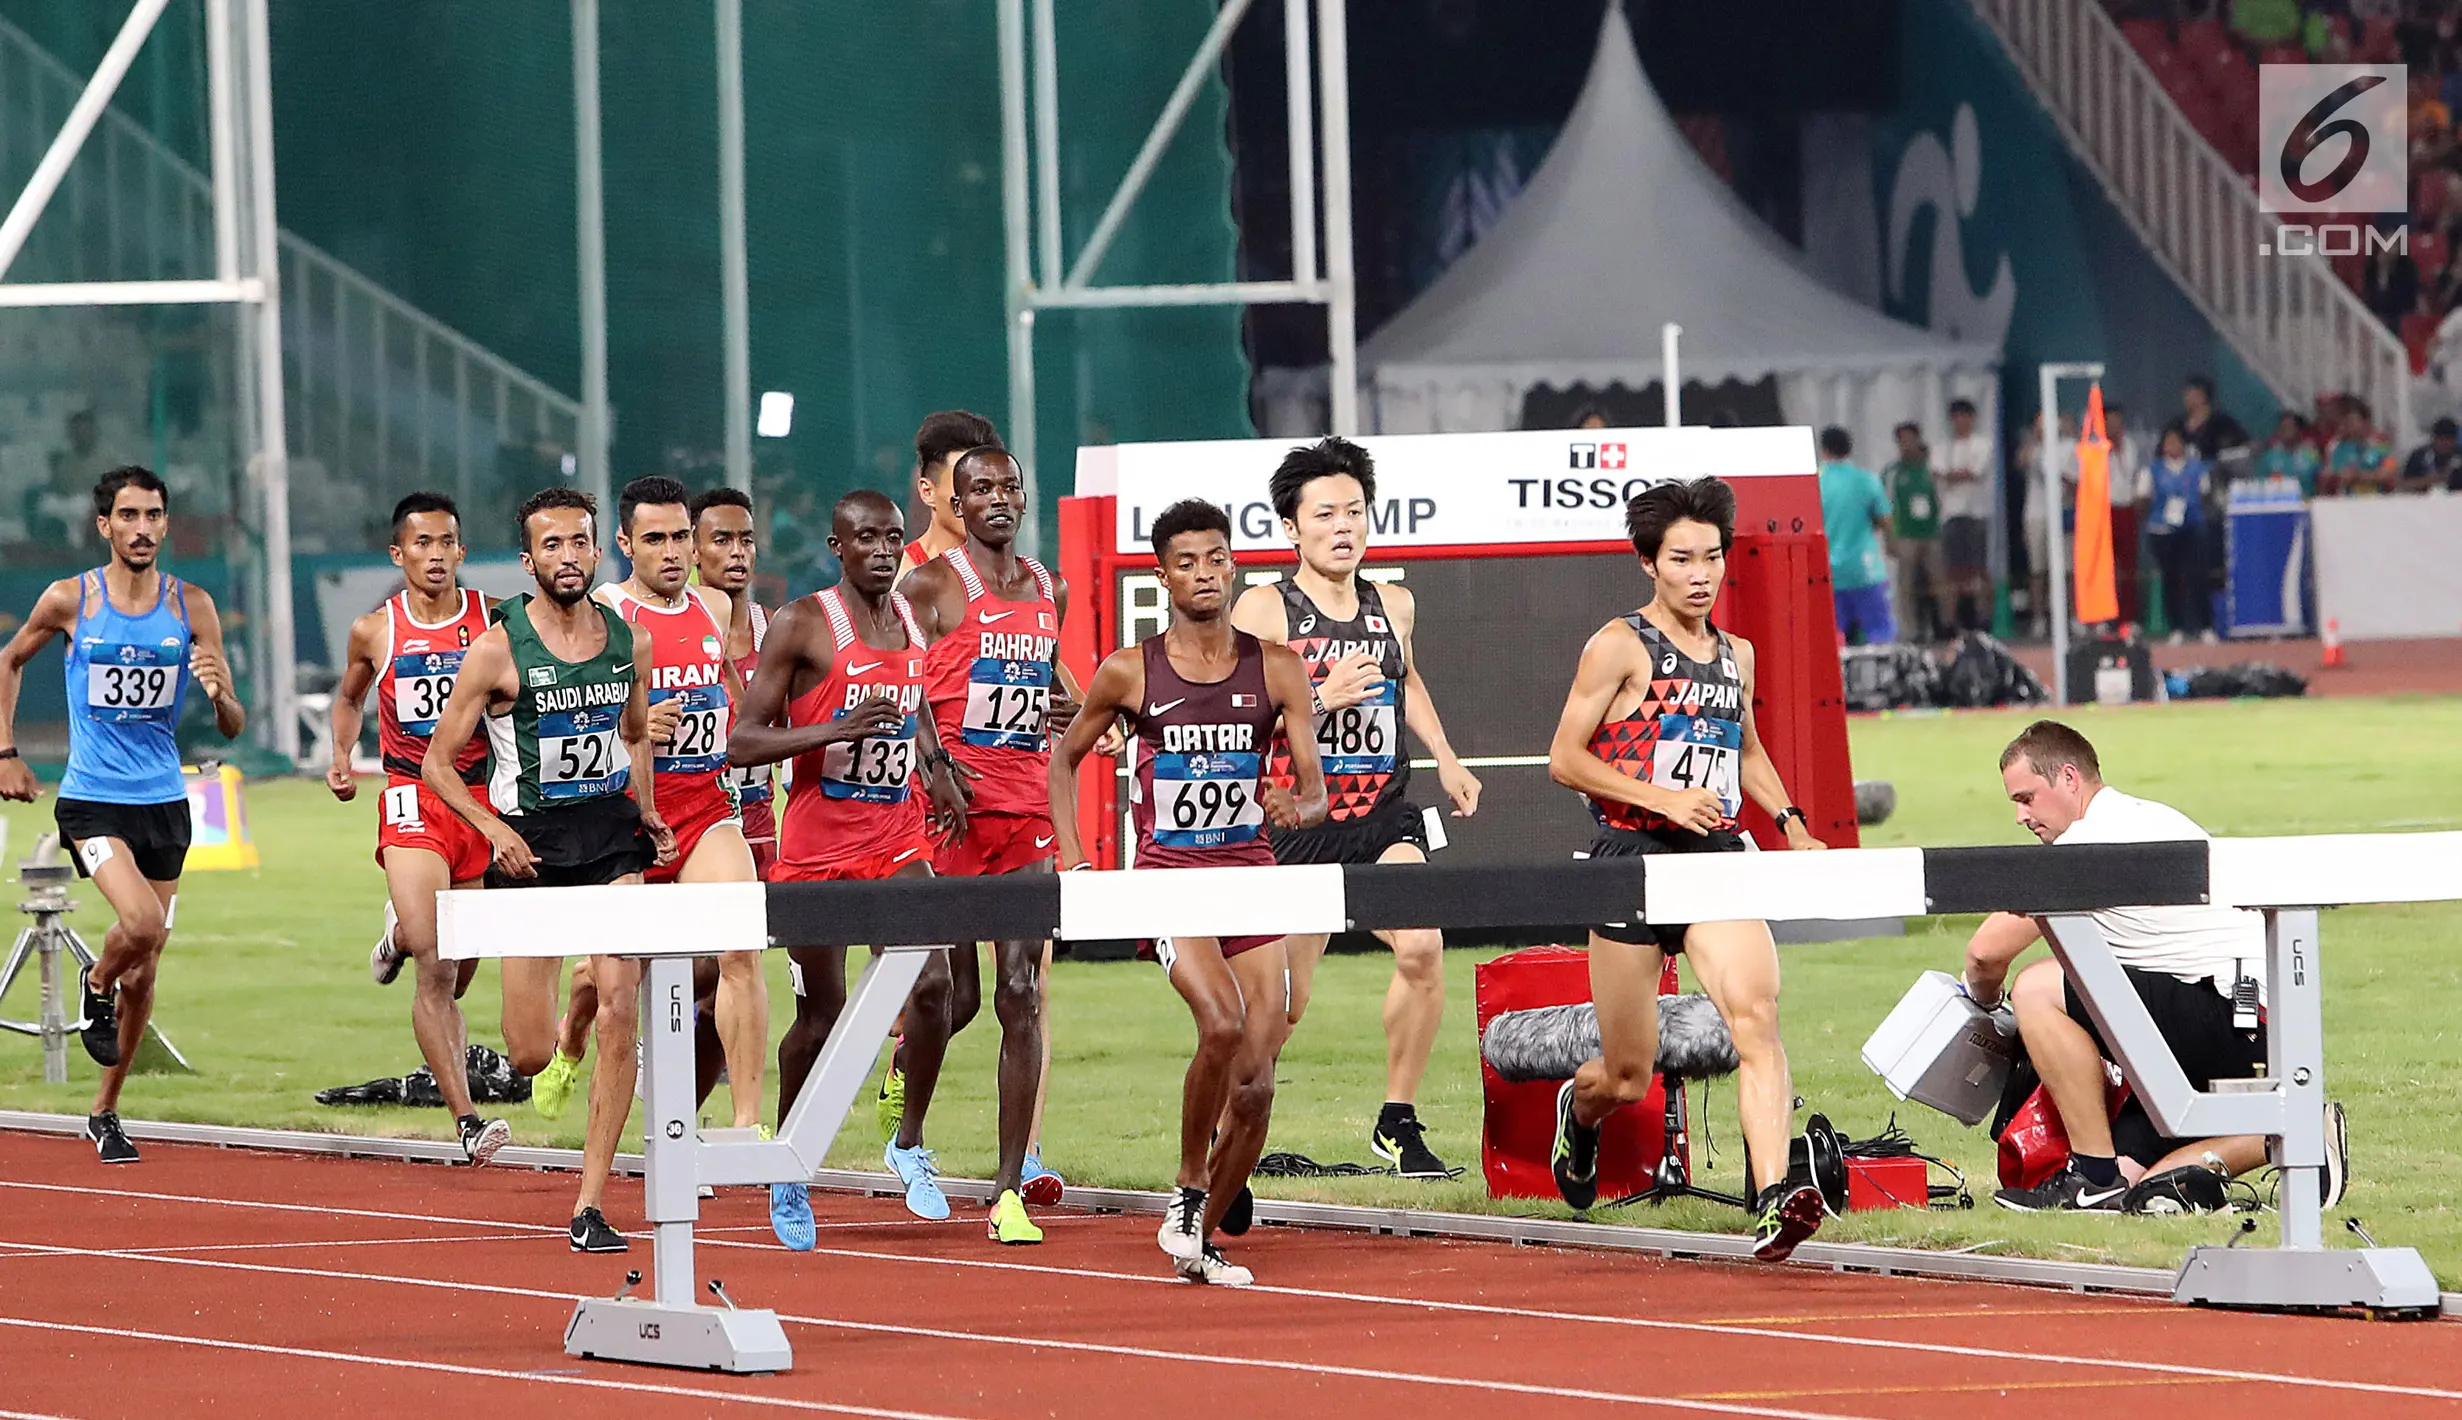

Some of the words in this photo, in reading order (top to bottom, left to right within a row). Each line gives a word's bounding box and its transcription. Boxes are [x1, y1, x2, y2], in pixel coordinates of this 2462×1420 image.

[1508, 479, 1670, 508] TISSO
[980, 631, 1056, 662] BAHRAIN
[104, 667, 165, 707] 339
[652, 663, 720, 689] IRAN
[413, 676, 454, 719] 38
[535, 686, 582, 713] SAUDI
[585, 681, 630, 706] ARABIA
[984, 686, 1045, 734] 125
[1669, 681, 1738, 709] JAPAN
[1163, 724, 1253, 754] QATAR
[1317, 708, 1384, 755] 486
[843, 740, 908, 786] 133
[396, 792, 406, 818] 1
[1173, 781, 1247, 829] 699
[1205, 831, 1225, 844] BNI
[88, 843, 99, 864] 9
[2292, 938, 2305, 986] UCS
[670, 984, 682, 1033] UCS
[639, 1323, 660, 1339] UCS
